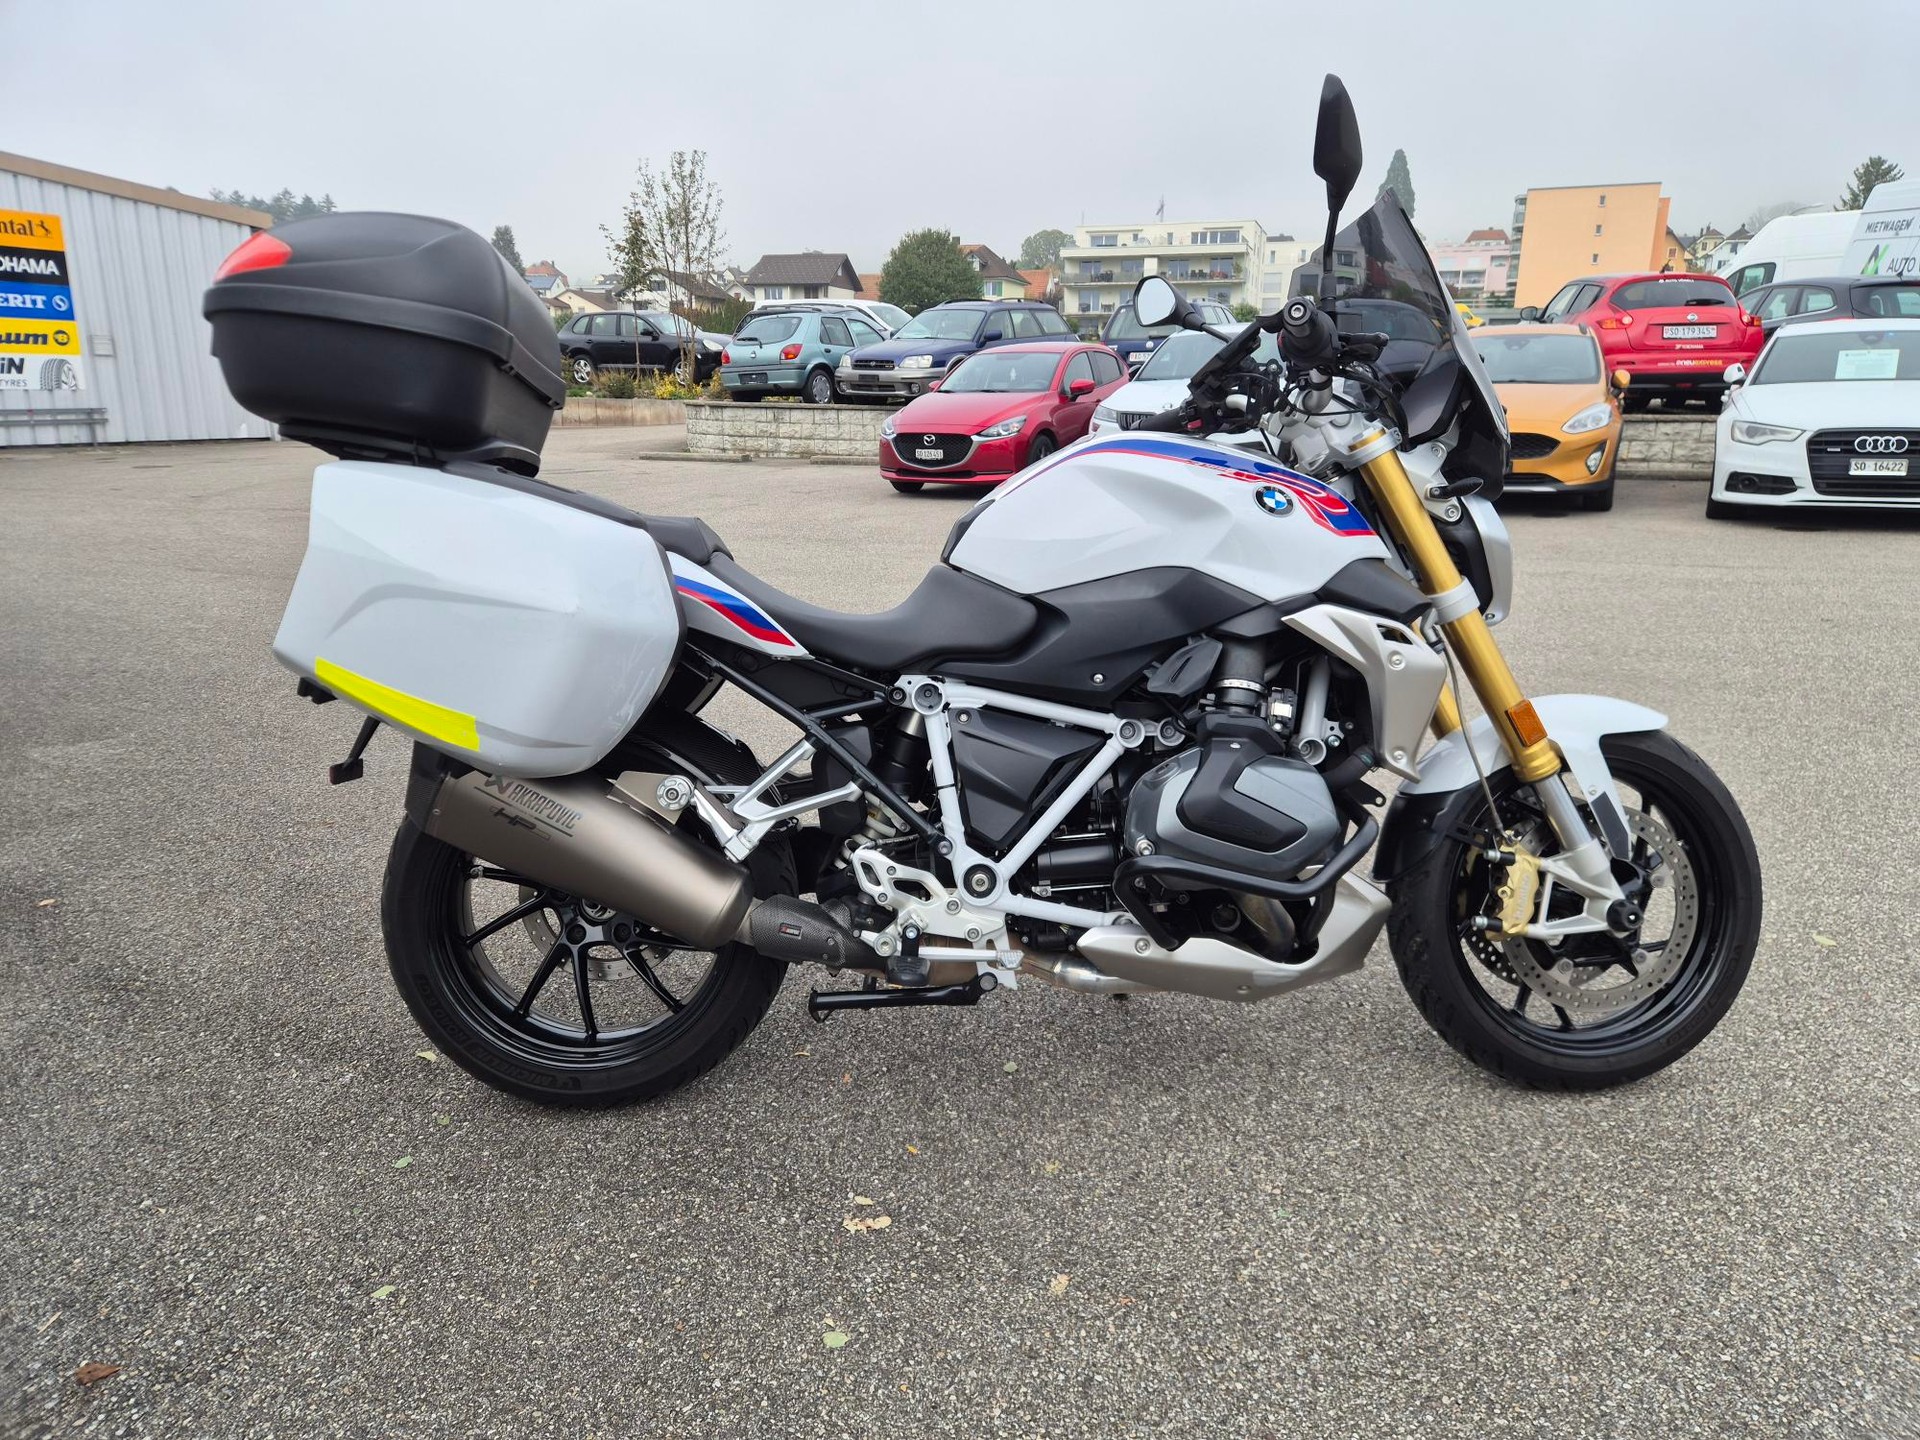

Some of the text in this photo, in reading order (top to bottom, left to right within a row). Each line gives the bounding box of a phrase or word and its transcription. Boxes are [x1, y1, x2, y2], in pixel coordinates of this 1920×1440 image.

[1864, 217, 1914, 233] MIETWAGEN
[1886, 256, 1916, 273] AUTO
[1853, 461, 1904, 472] SO 16422
